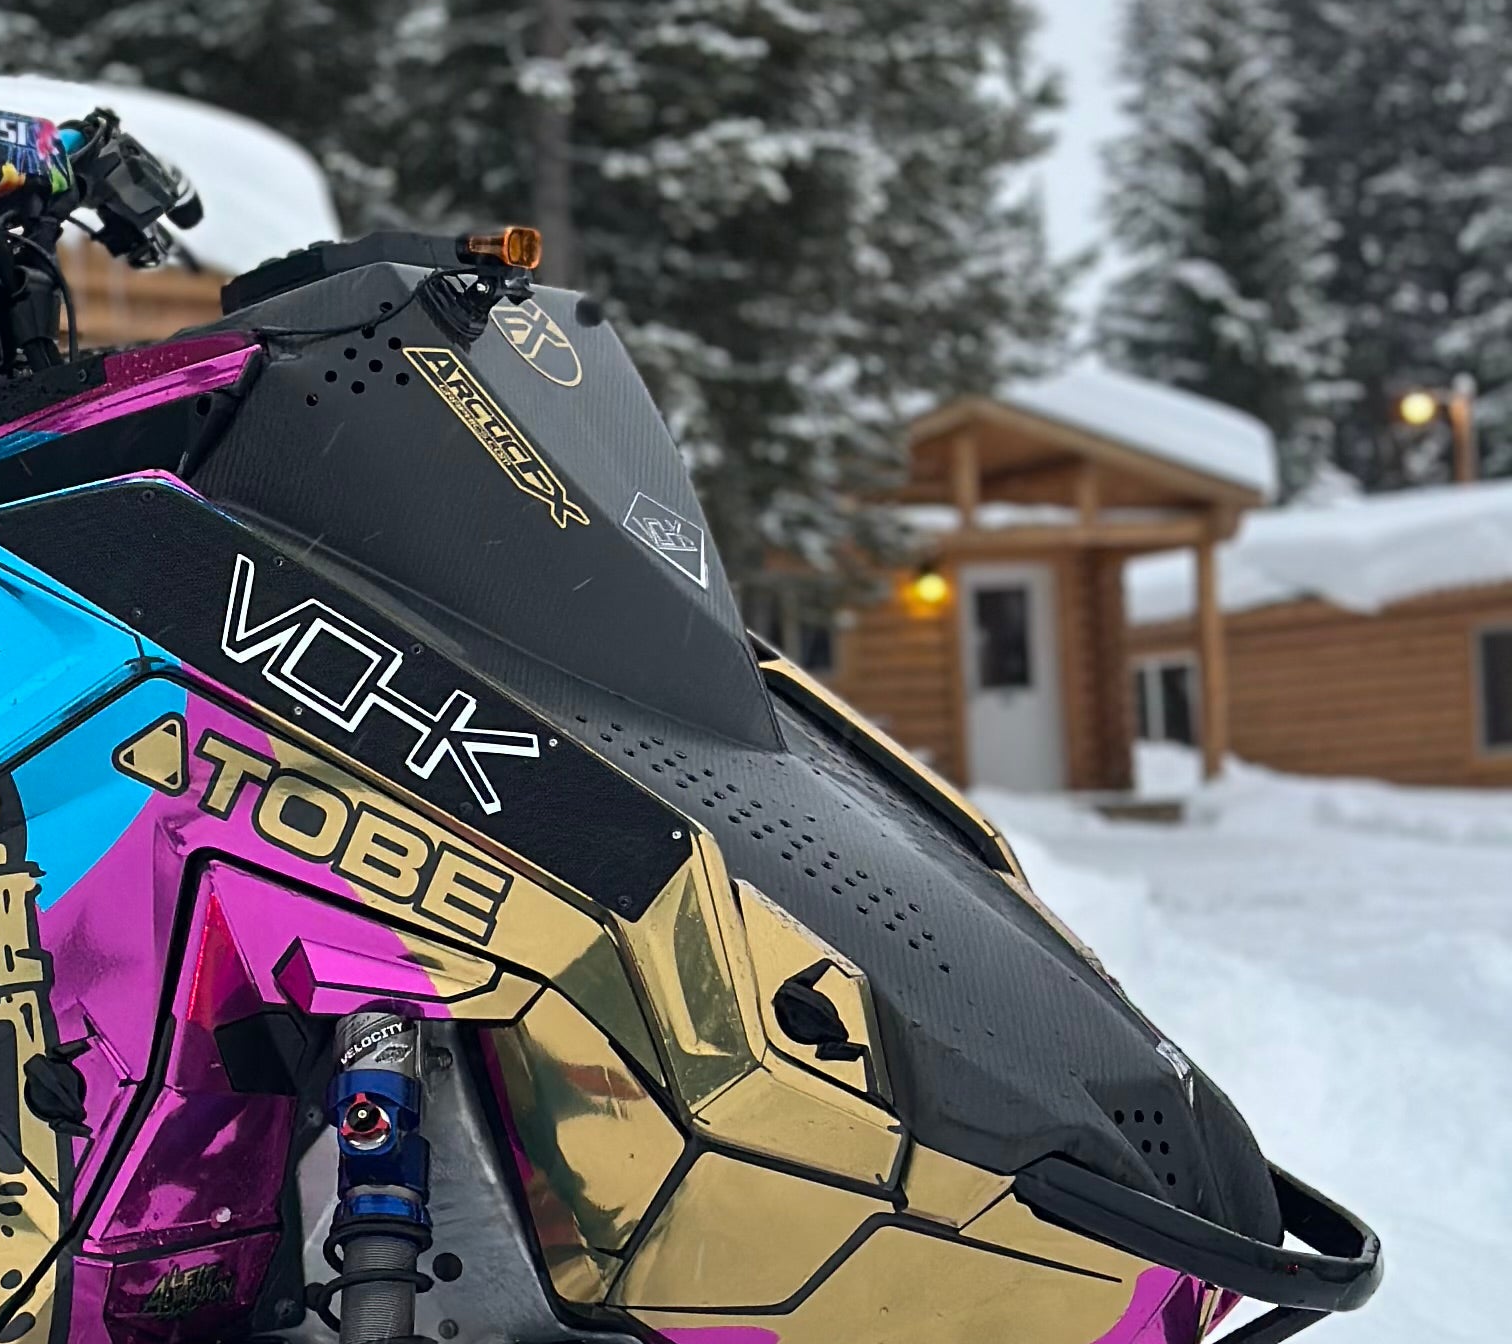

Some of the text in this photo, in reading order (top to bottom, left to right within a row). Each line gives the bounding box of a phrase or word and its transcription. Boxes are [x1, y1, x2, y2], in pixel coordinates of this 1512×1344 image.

[222, 554, 540, 815] VOHK
[199, 734, 510, 941] TOBE
[340, 1022, 403, 1065] VELOCITY
